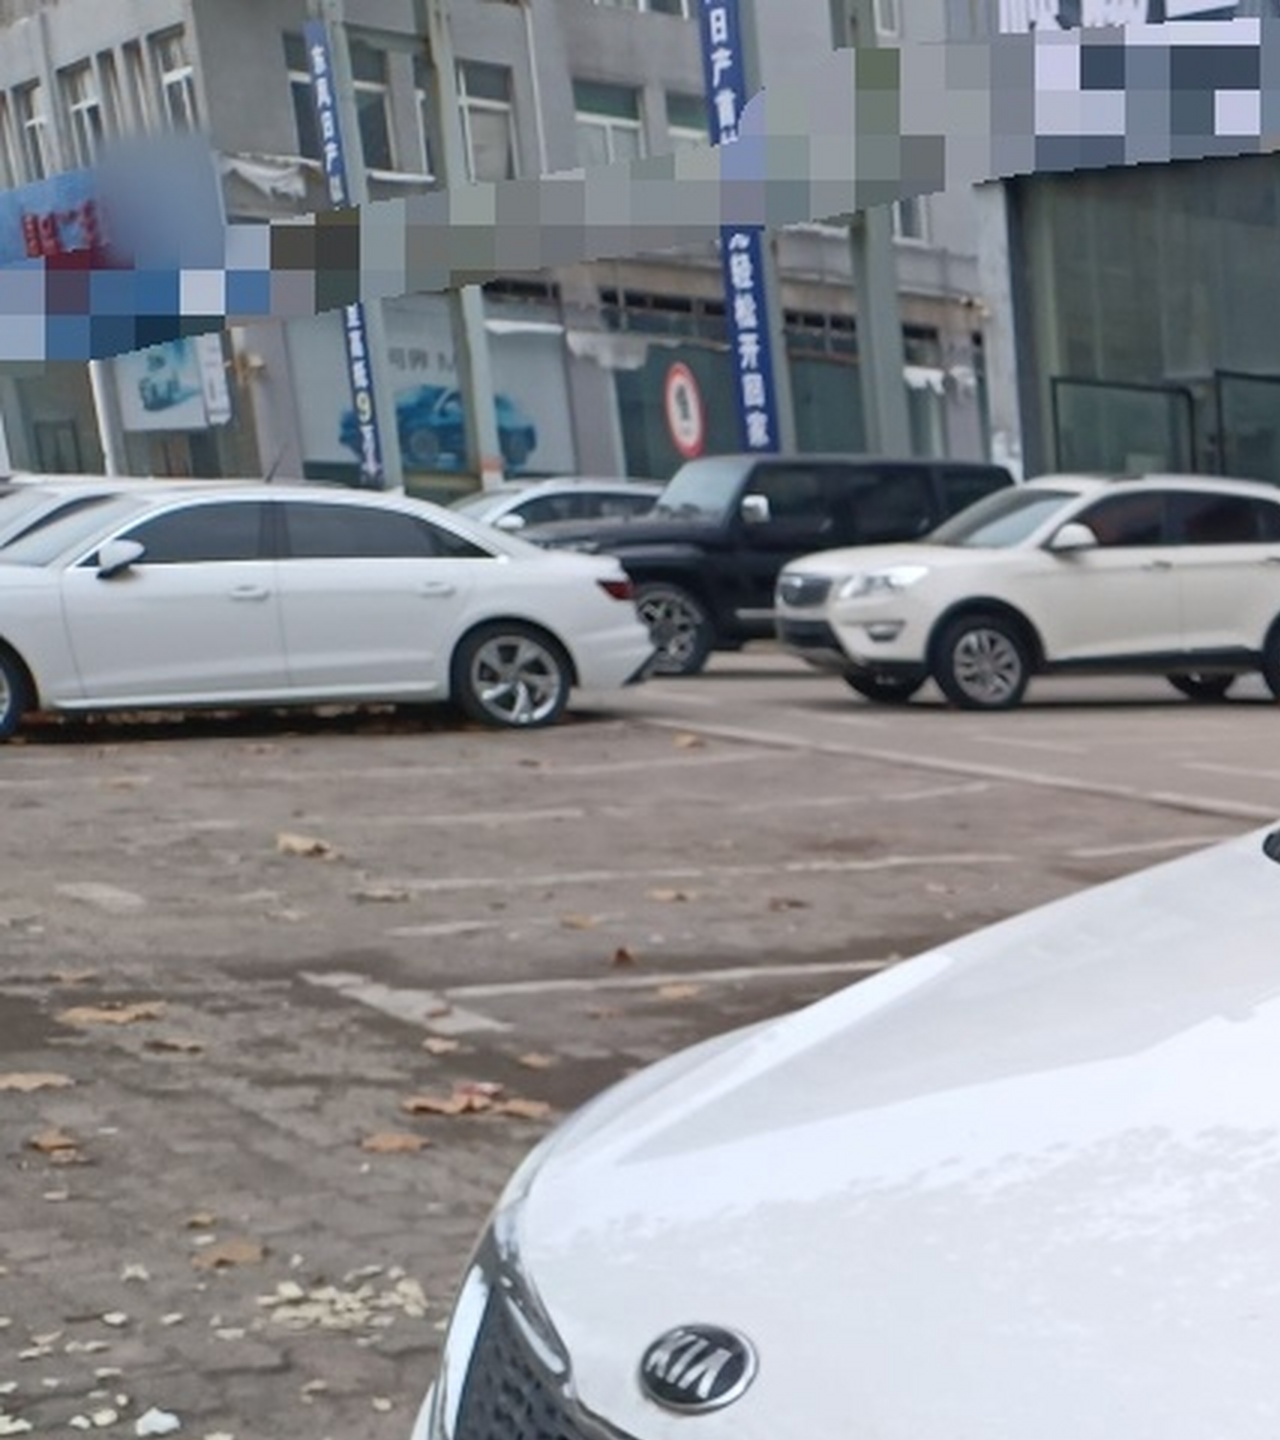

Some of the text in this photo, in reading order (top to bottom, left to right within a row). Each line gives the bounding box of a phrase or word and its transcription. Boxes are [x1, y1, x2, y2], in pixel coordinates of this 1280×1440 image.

[709, 7, 739, 144] 日产首
[645, 1330, 733, 1399] KIA
